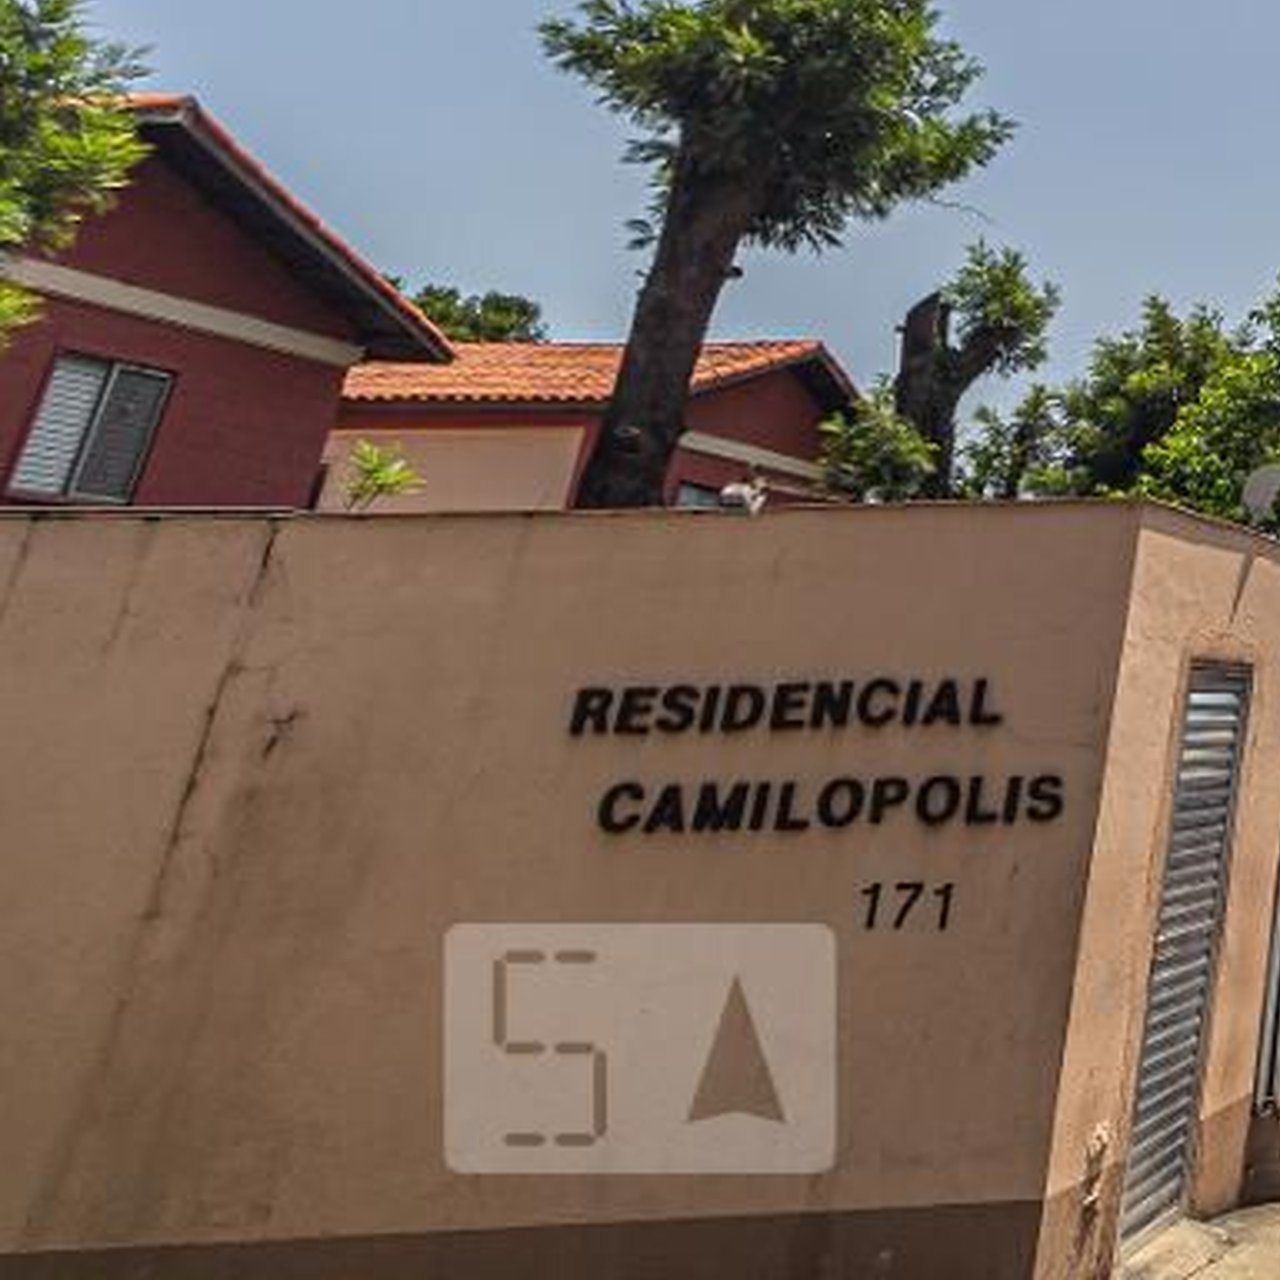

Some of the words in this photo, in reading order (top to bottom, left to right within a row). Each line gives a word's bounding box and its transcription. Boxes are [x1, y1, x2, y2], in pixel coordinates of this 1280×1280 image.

[570, 678, 1005, 736] RESIDENCIAL
[599, 775, 1065, 834] CAMILOPOLIS
[860, 881, 955, 931] 171
